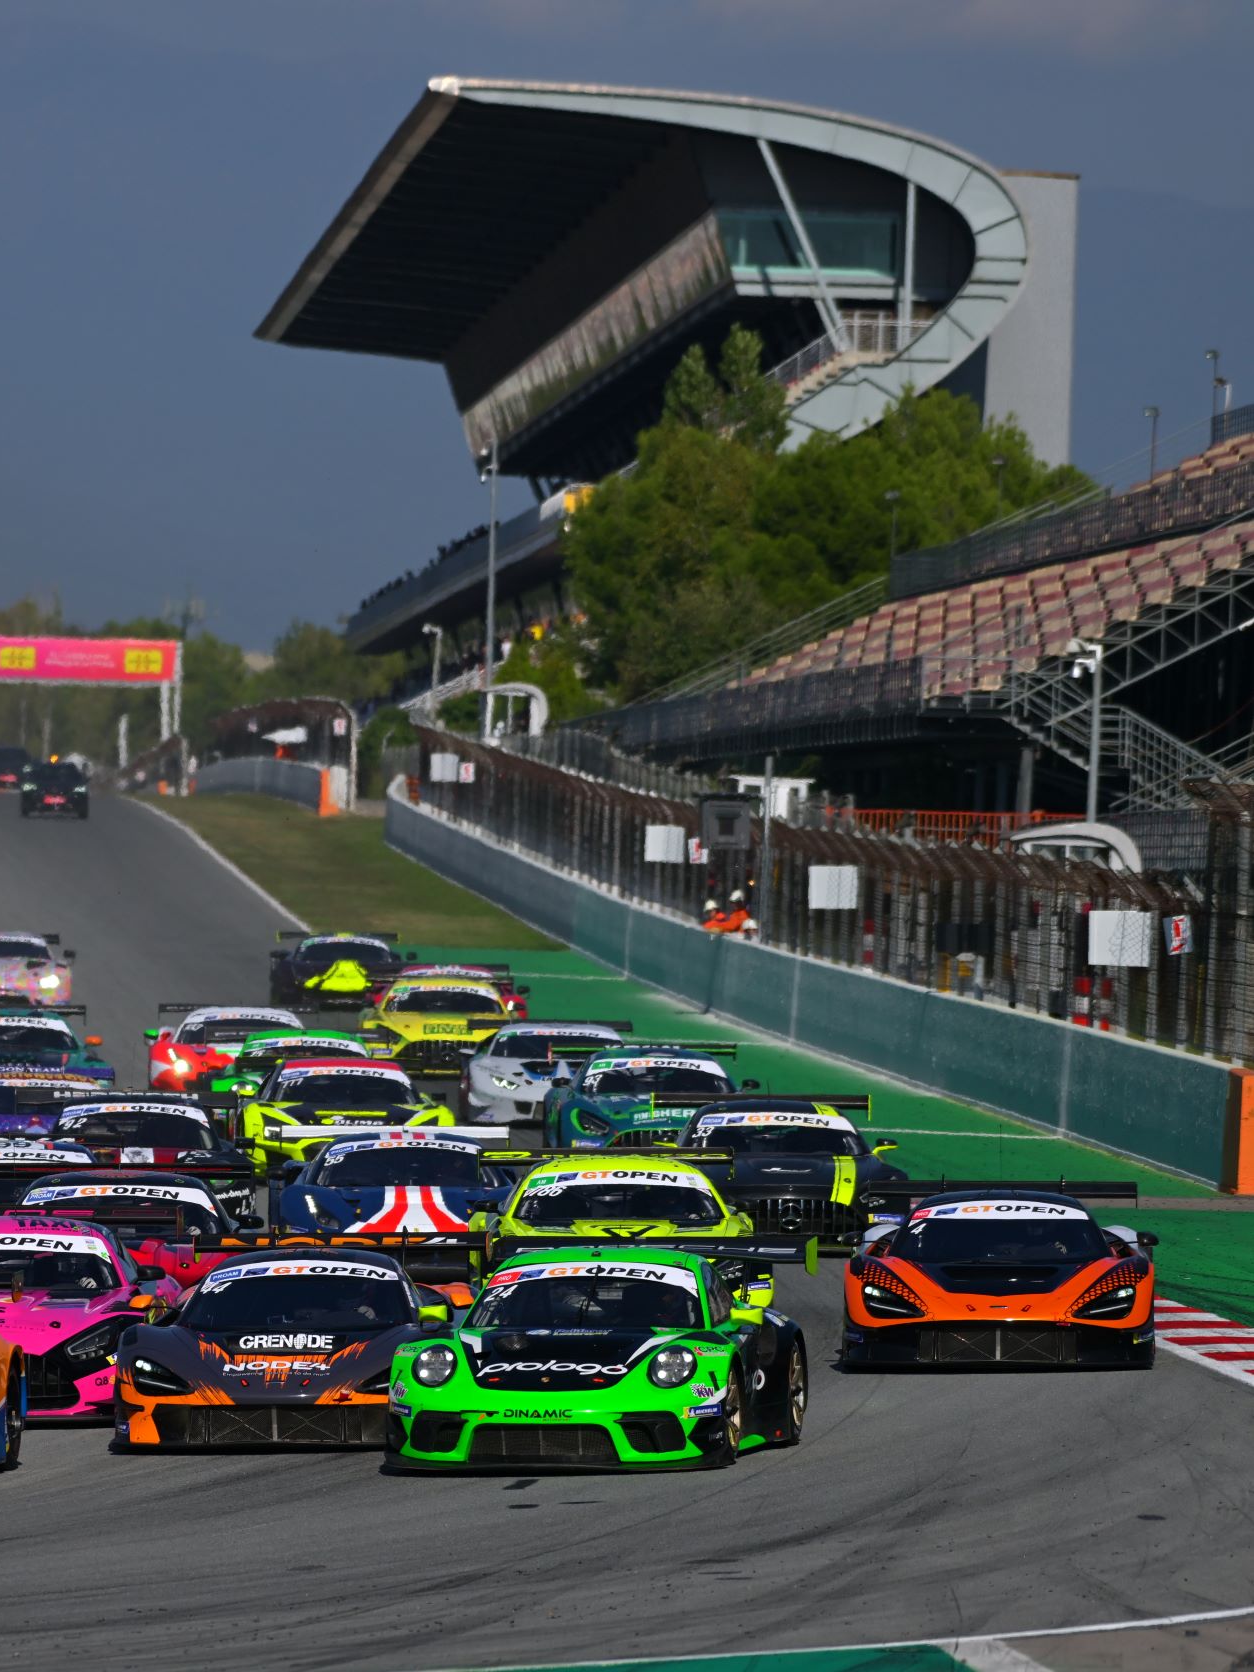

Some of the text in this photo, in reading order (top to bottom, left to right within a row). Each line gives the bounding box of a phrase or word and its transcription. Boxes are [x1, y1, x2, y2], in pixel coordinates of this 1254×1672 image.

[105, 1105, 187, 1115] GTOPEN
[747, 1115, 831, 1127] GTOPEN
[691, 1126, 715, 1139] 33
[378, 1141, 467, 1152] GTOPEN
[323, 1155, 345, 1167] 55
[580, 1170, 679, 1184] GTOPEN
[29, 1192, 53, 1200] PROAM
[79, 1186, 180, 1201] GTOPEN
[914, 1210, 930, 1218] PRO
[961, 1205, 1067, 1216] GTOPEN
[909, 1222, 928, 1235] 4
[212, 1271, 240, 1281] PROAM
[272, 1265, 388, 1280] GTOPEN
[496, 1274, 513, 1283] PRO
[547, 1266, 667, 1281] GTOPEN
[483, 1284, 519, 1303] 24
[223, 1360, 331, 1372] NODE4
[476, 1359, 629, 1377] prologo
[94, 1376, 109, 1386] Q8
[502, 1408, 574, 1419] DINAMIC
